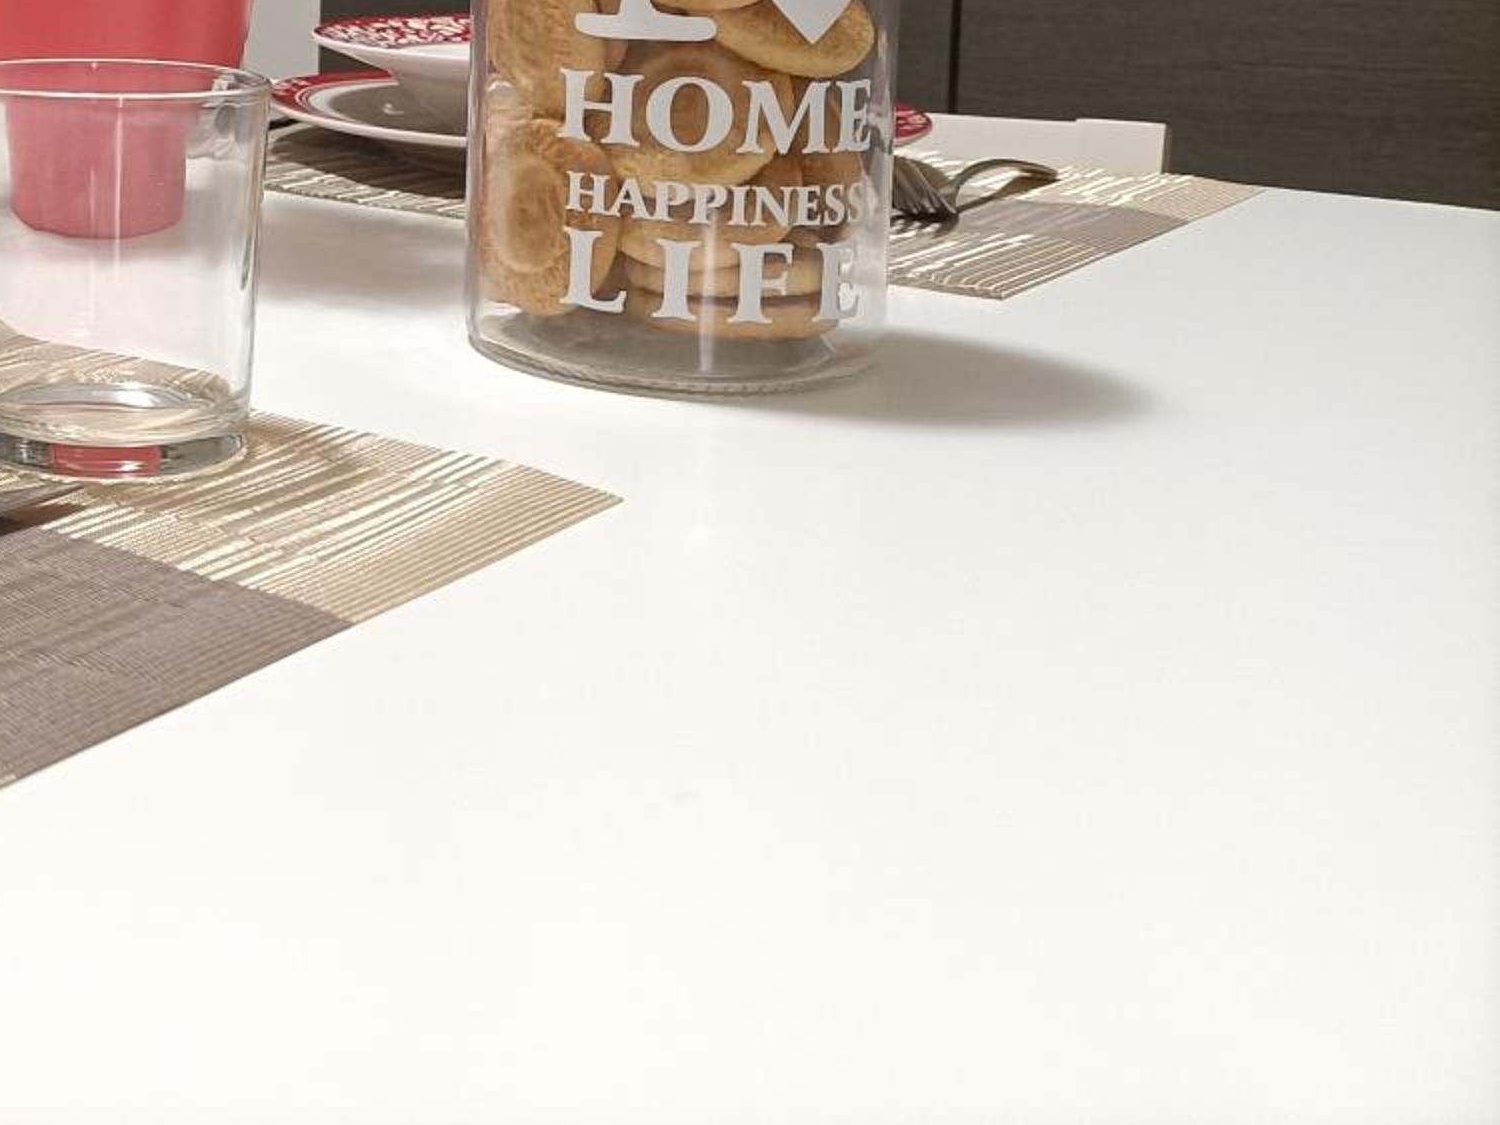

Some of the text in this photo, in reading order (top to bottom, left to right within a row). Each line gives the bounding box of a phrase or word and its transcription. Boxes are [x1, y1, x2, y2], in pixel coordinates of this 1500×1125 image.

[556, 67, 872, 155] HOME
[565, 170, 867, 228] HAPPINESS
[559, 225, 866, 325] LIFE
